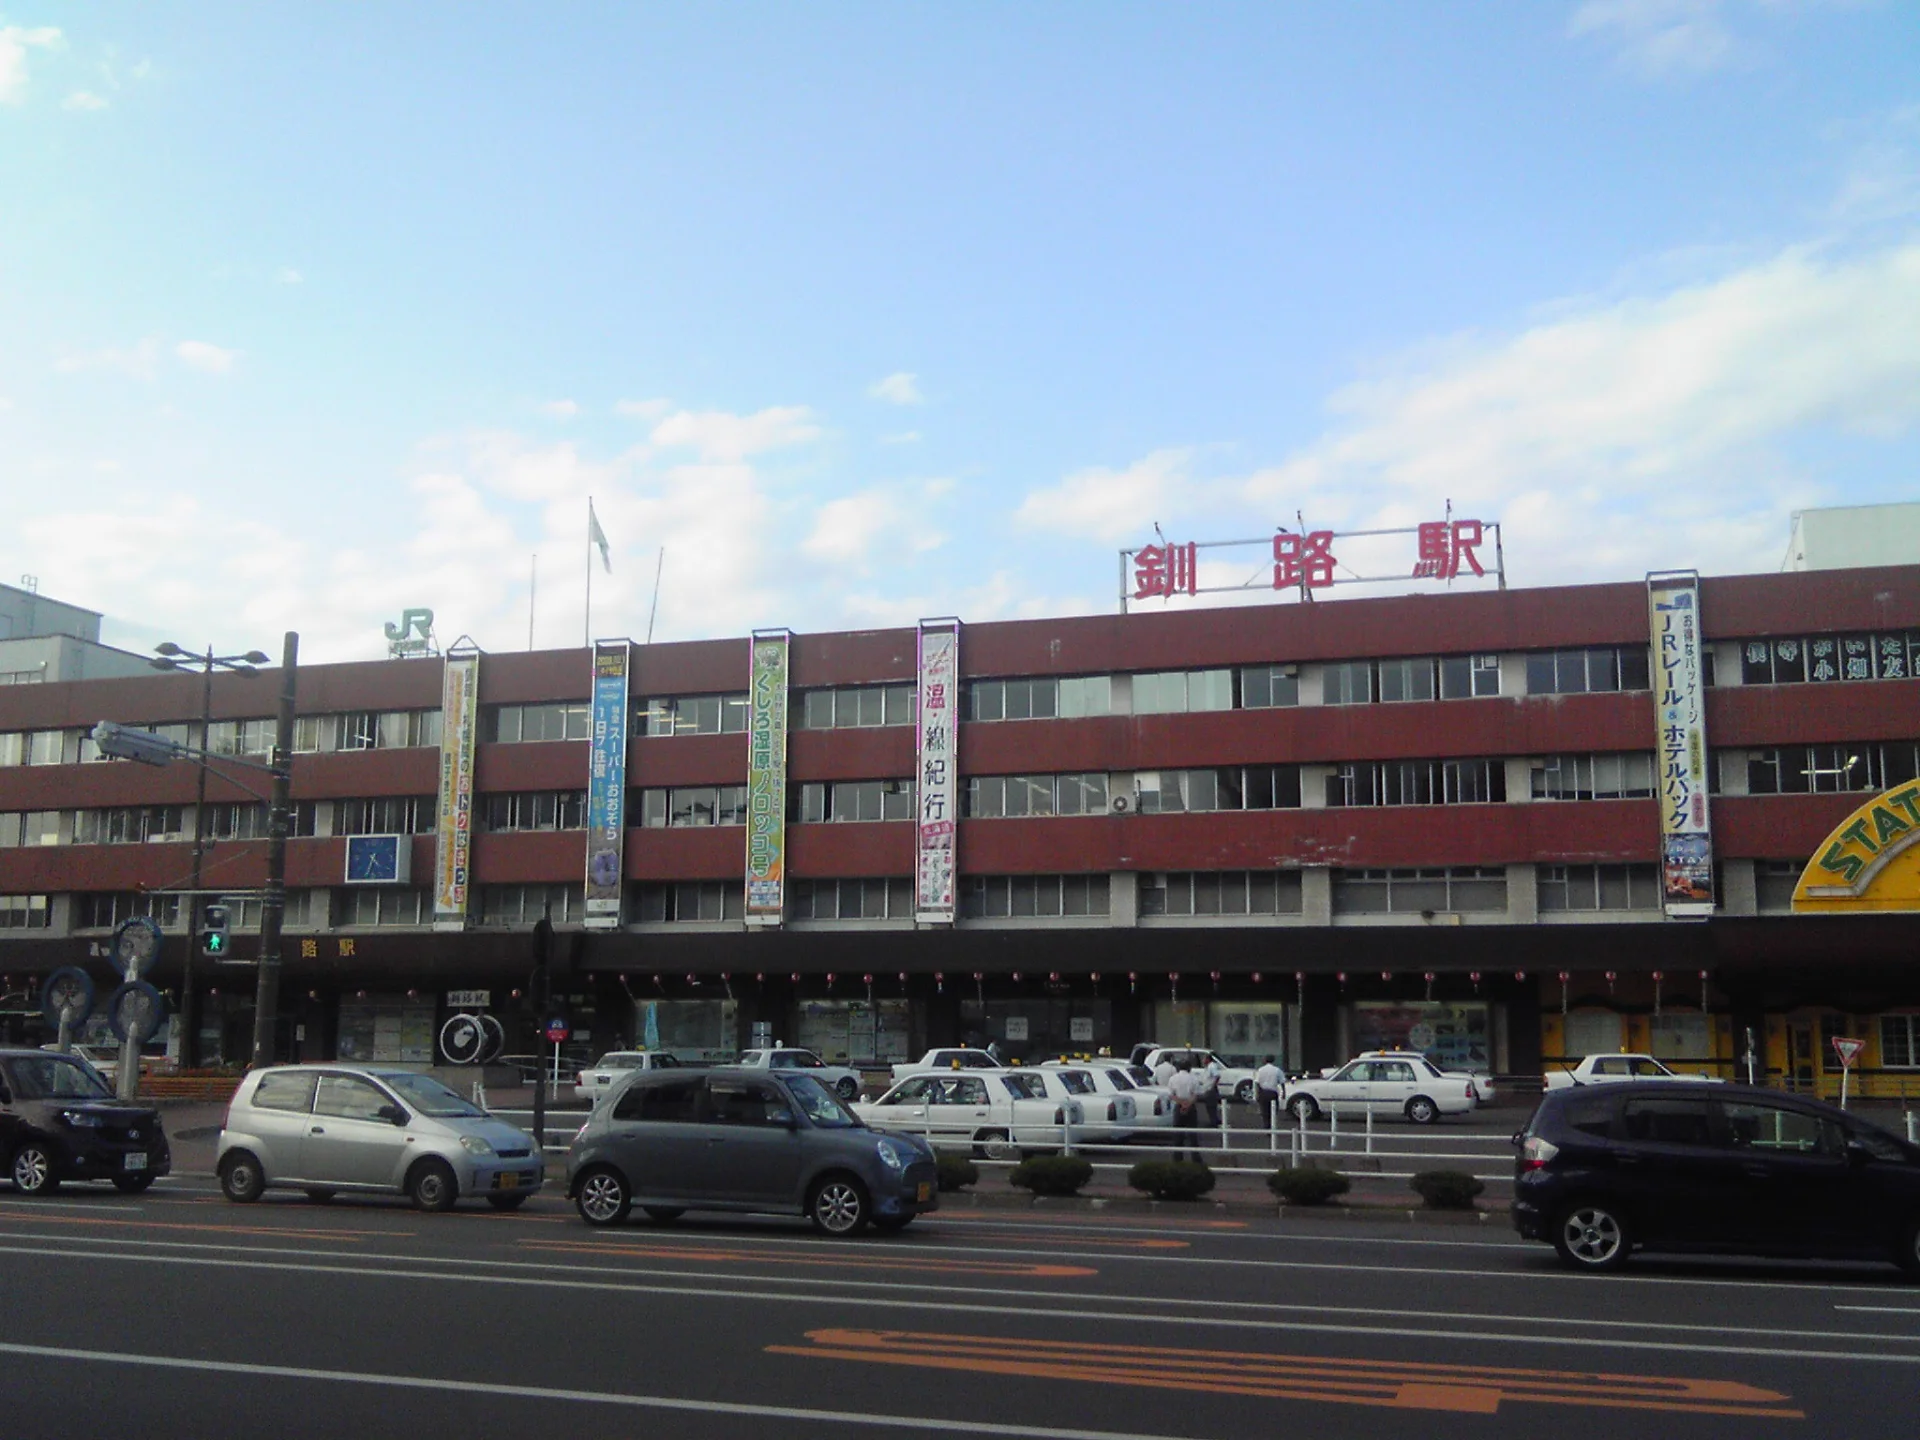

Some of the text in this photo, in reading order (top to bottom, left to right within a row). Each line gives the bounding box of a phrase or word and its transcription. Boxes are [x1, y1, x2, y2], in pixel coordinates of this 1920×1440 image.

[1134, 519, 1485, 600] 釧路駅
[384, 608, 434, 640] JR
[750, 672, 773, 878] くしろ湿原ノロッコ号
